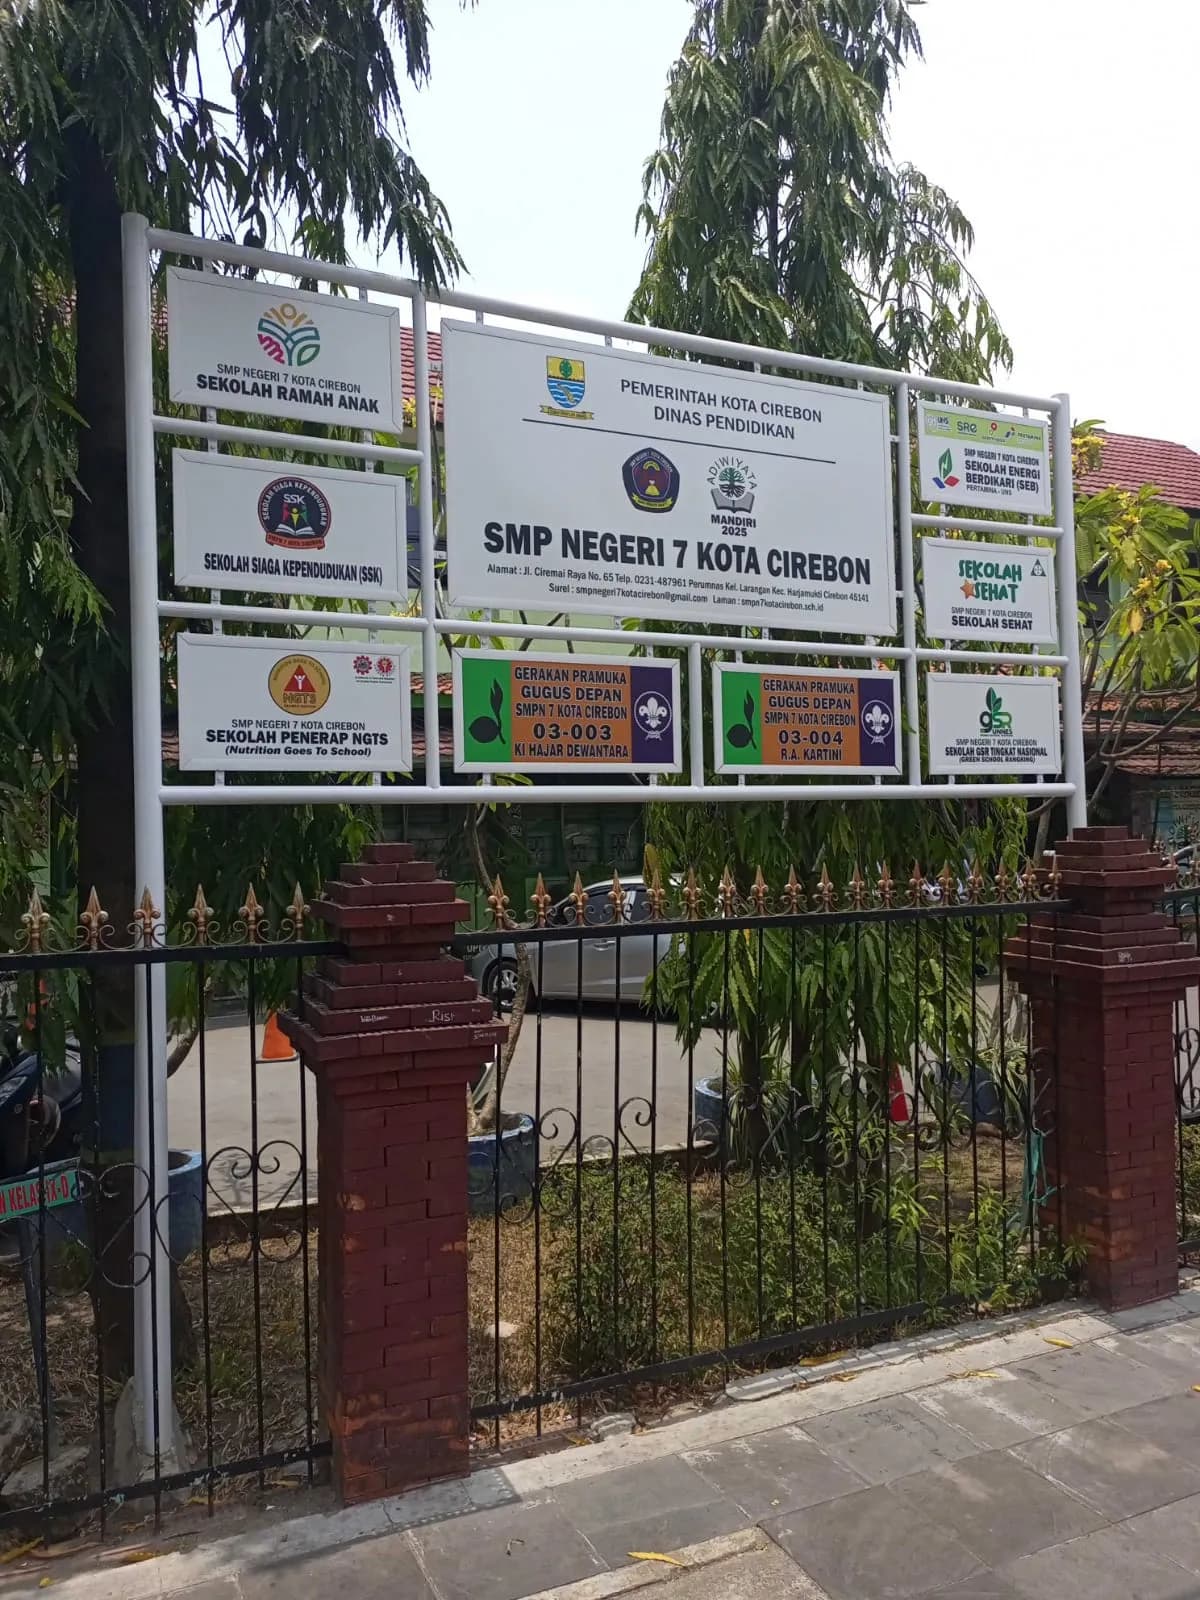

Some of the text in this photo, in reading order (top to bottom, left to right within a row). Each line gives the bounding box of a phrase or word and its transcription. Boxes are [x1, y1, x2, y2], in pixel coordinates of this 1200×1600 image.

[216, 363, 361, 394] SMP NEGERI 7 KOTA CIREBON
[196, 374, 380, 414] SEKOLAH RAMAH ANAK
[620, 379, 822, 423] PEMERINTAH KOTA CIREBON
[654, 406, 795, 440] DINAS PENDIDIKAN
[964, 448, 976, 457] SMP
[977, 450, 996, 461] NEGERI
[1002, 454, 1016, 463] KOTA
[1017, 456, 1040, 466] CIREBON
[706, 456, 758, 490] ADIWIYATA
[964, 460, 1040, 480] SEKOLAH ENERGI
[966, 472, 1039, 494] BERDIKARI (SEB)
[284, 494, 305, 504] SSK
[710, 514, 756, 528] MANDIRI
[722, 526, 748, 537] 2025
[484, 522, 871, 586] SMP NEGERI 7 KOTA CIREBON
[204, 552, 383, 587] SEKOLAH SIAGA KEPENDUDUKAN (SSK)
[958, 560, 1022, 582] SEKOLAH
[488, 564, 518, 575] Alamat
[523, 566, 532, 576] Jl.
[534, 568, 566, 578] Ciremai
[567, 570, 586, 582] Raya
[588, 572, 602, 582] No.
[603, 572, 614, 582] 65
[616, 574, 632, 585] Telp.
[634, 574, 686, 588] 0231-487961
[688, 580, 724, 590] Perumnas
[725, 582, 738, 592] Kel.
[740, 583, 770, 595] Larangan
[772, 586, 785, 596] Kec.
[824, 590, 848, 600] Cirebon
[849, 592, 869, 602] 45141
[548, 582, 570, 593] Surel
[576, 586, 708, 602] smpnegeri7kotacirebon@gmail.com
[713, 596, 736, 605] Laman
[742, 600, 824, 612] smpn7kotacirebon.sch.id
[974, 582, 1018, 604] SEHAT
[952, 606, 964, 614] SMP
[966, 608, 986, 616] NEGERI
[992, 609, 1006, 617] KOTA
[1008, 610, 1032, 619] CIREBON
[952, 616, 1032, 631] SEKOLAH SEHAT
[515, 667, 626, 684] GERAKAN PRAMUKA
[522, 686, 622, 702] GUGUS DEPAN
[764, 680, 855, 694] GERAKAN PRAMUKA
[768, 696, 852, 710] GUGUS DEPAN
[516, 703, 627, 720] SMPN 7 KOTA CIREBON
[764, 712, 856, 726] SMPN 7 KOTA CIREBON
[232, 718, 366, 731] SMP NEGERI 7 KOTA CIREBON
[533, 724, 612, 740] 03-003
[206, 730, 388, 746] SEKOLAH PENERAP NGTS
[778, 730, 843, 745] 03-004
[956, 738, 969, 746] SMP
[225, 745, 372, 758] (Nutrition Goes To School)
[514, 743, 628, 758] KI HAJAR DEWANTARA
[781, 748, 842, 760] R.A. KARTINI
[945, 747, 1048, 757] SEKOLAH GSR TINGKAT NASIONAL
[959, 756, 980, 764] (GREEN
[1005, 756, 1036, 764] RANGKING)
